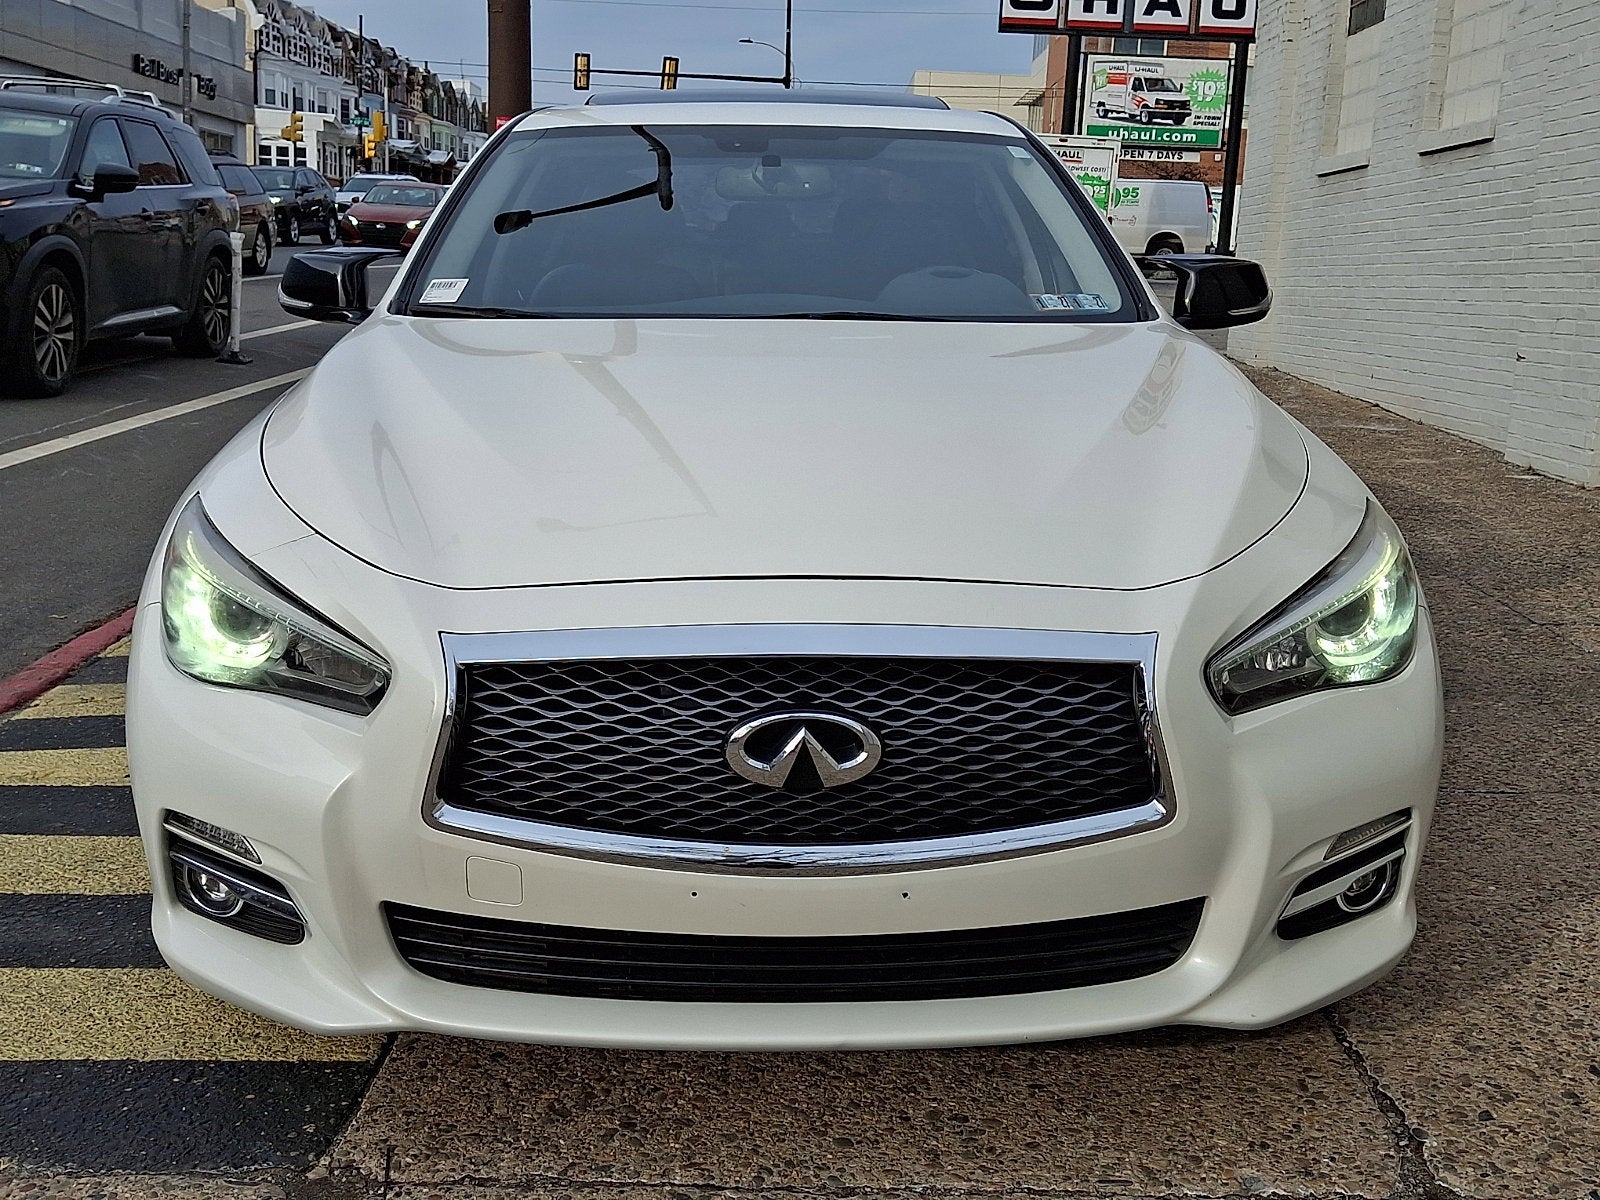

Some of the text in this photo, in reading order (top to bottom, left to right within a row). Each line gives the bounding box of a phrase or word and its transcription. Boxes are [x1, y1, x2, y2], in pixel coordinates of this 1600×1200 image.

[1108, 127, 1197, 142] uhaul.com
[1148, 150, 1154, 159] 7
[1156, 151, 1184, 160] DAYS
[1122, 187, 1140, 199] 95
